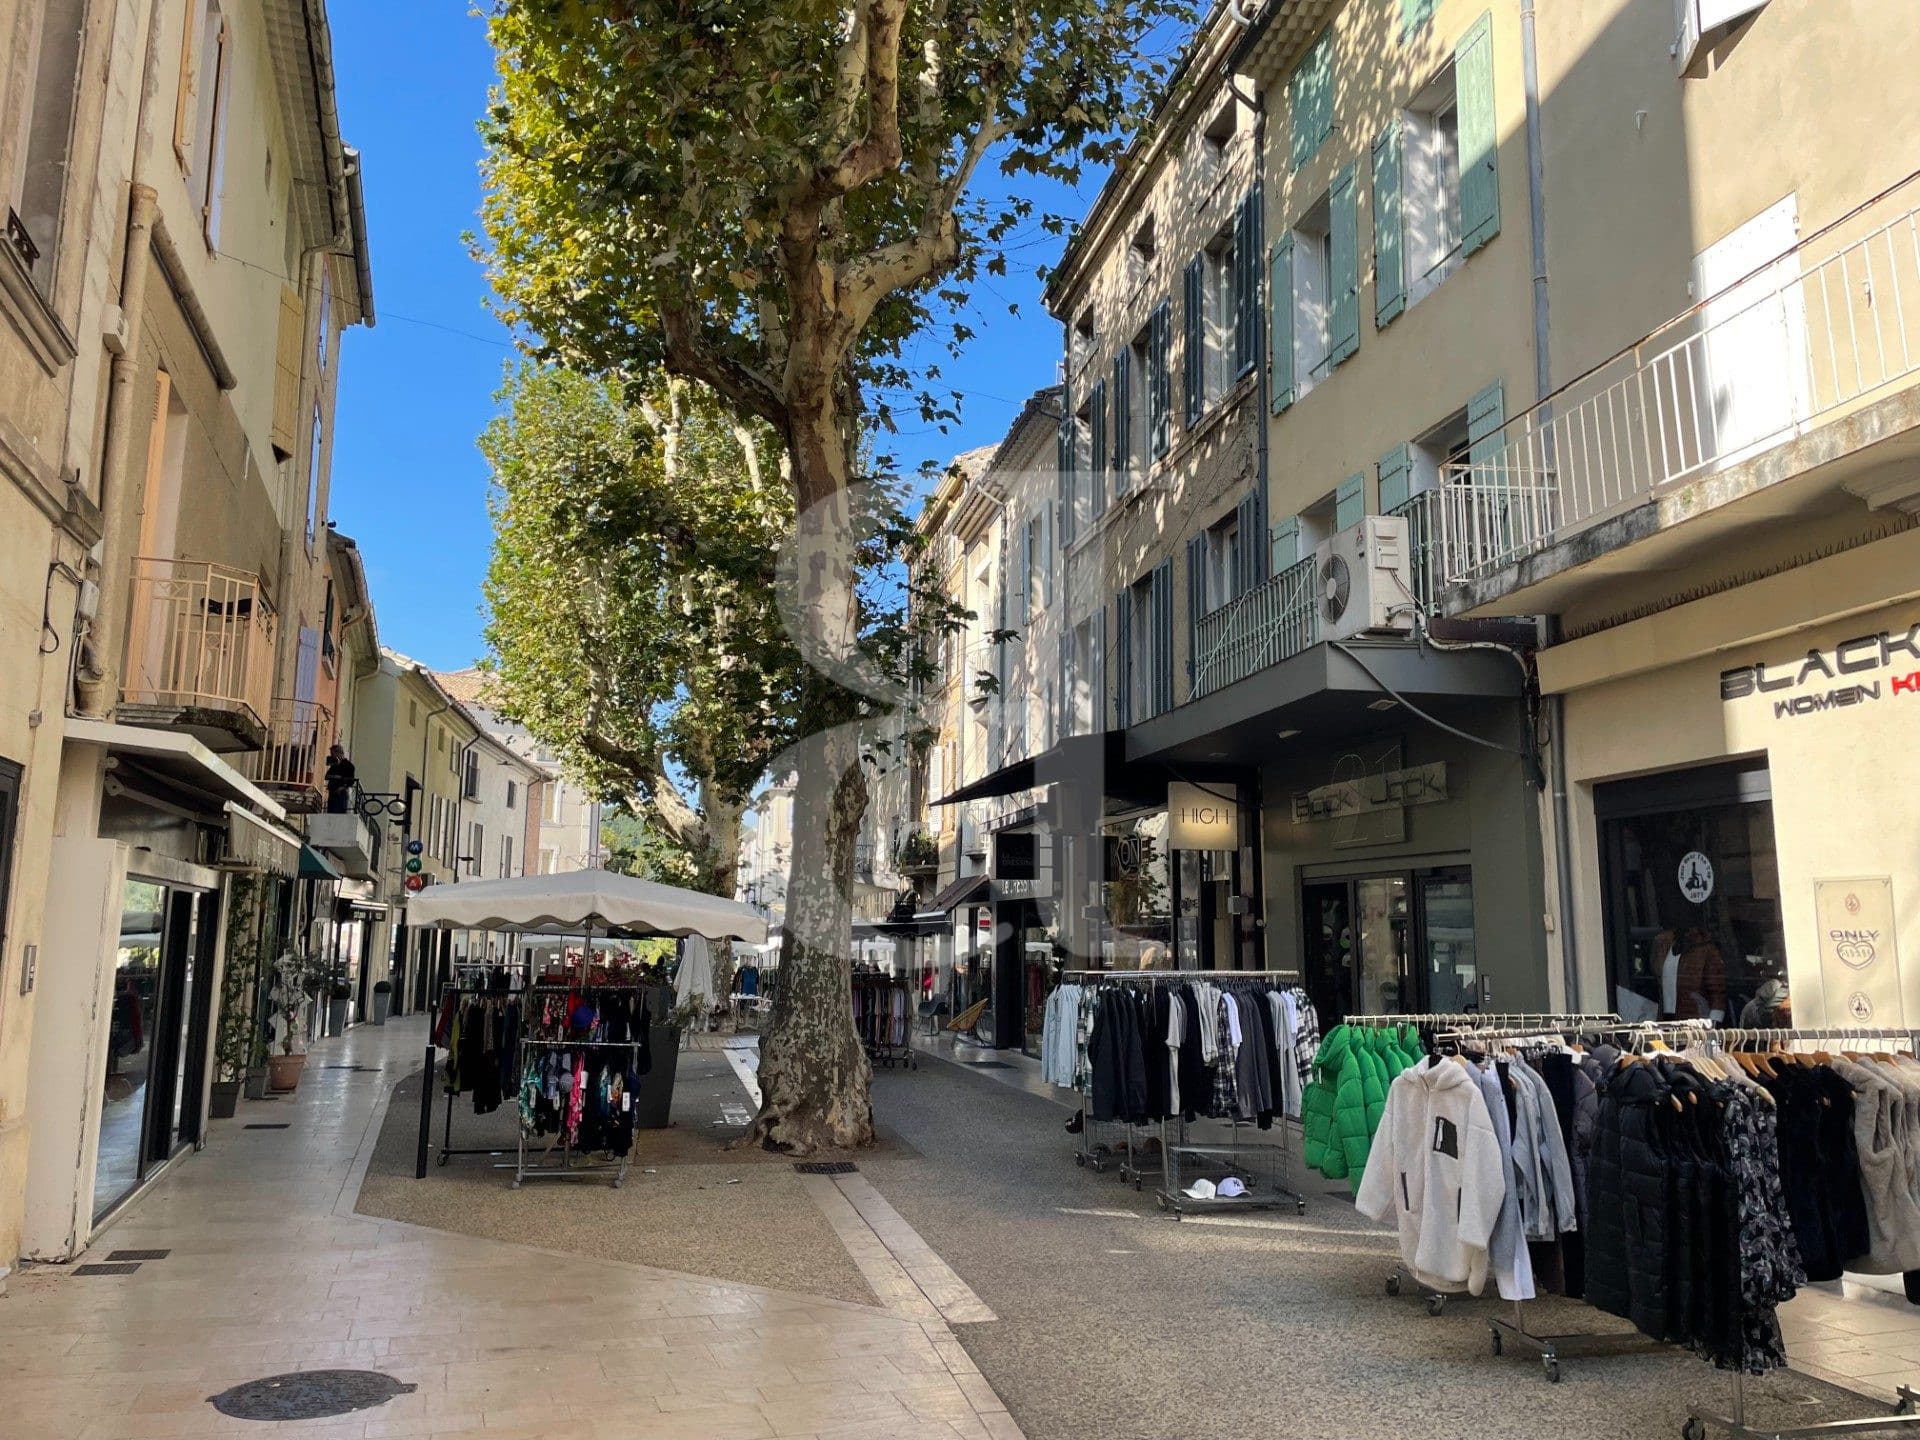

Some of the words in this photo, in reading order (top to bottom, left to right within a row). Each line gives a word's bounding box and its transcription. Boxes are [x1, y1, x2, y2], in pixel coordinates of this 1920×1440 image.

[1720, 622, 1920, 700] BLACK
[1774, 680, 1881, 719] WOMEN
[1829, 929, 1880, 941] ONLY
